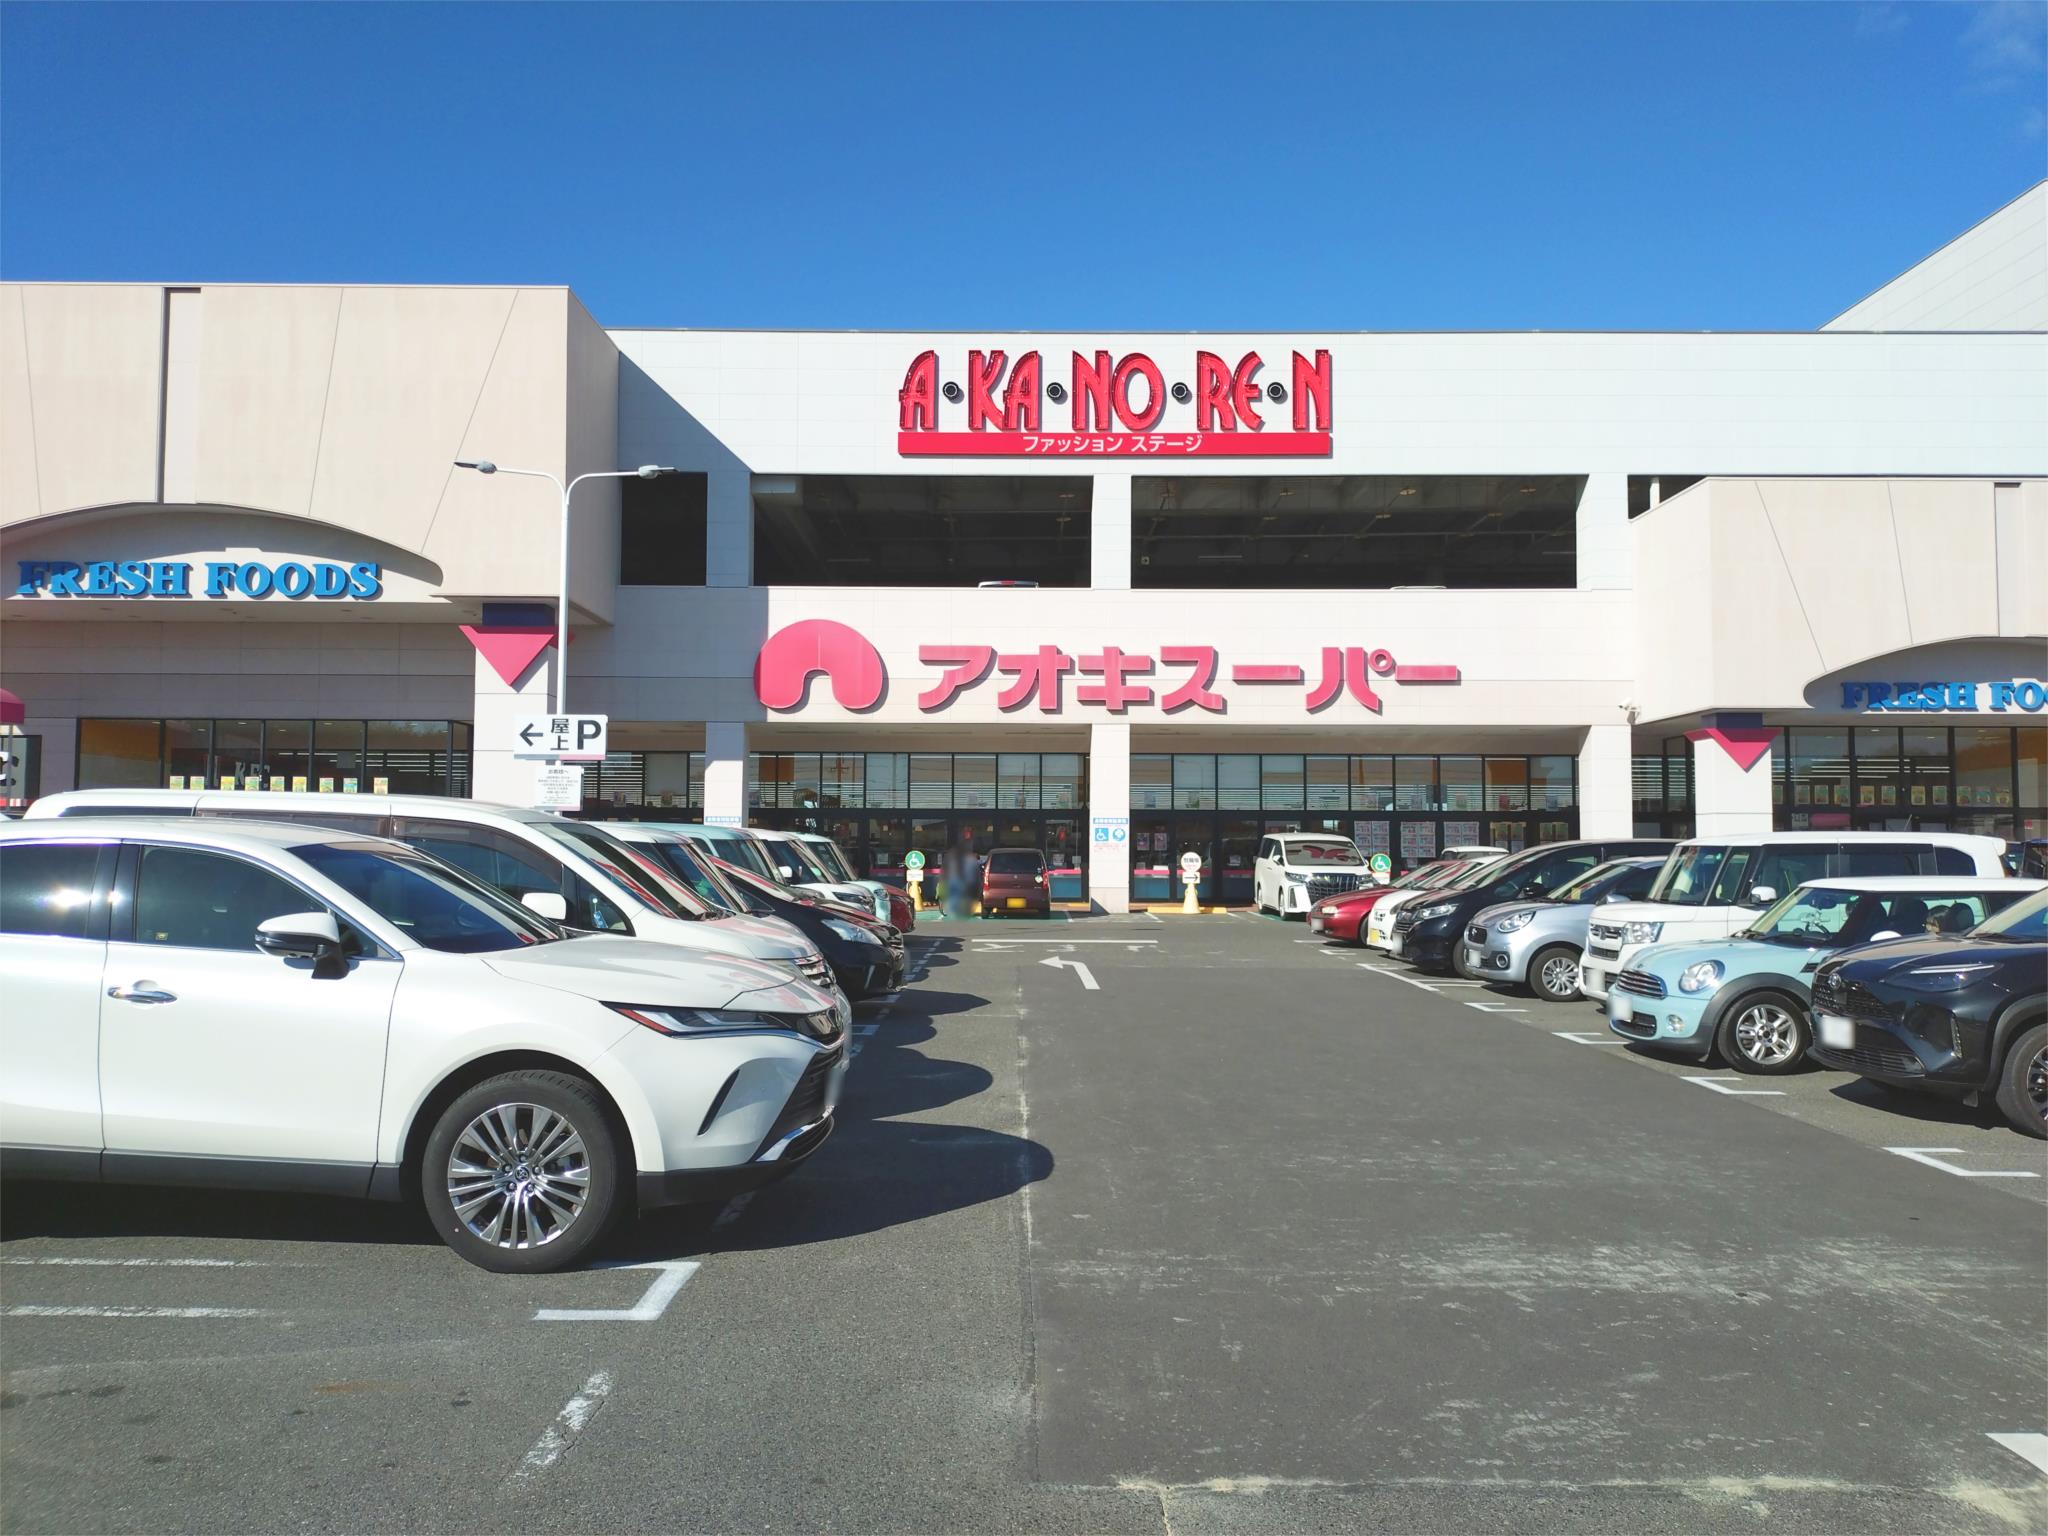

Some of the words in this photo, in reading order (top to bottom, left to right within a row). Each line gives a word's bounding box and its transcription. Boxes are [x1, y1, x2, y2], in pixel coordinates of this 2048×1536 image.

[1023, 435, 1123, 453] ファッション
[1131, 434, 1204, 453] ステージ
[16, 560, 190, 597] FRESH
[204, 560, 380, 598] FOODS
[917, 644, 1460, 712] アオキスーパー
[1840, 681, 1978, 711] FRESH
[1989, 680, 2048, 712] FO
[549, 718, 570, 751] 屋上
[577, 719, 602, 750] P
